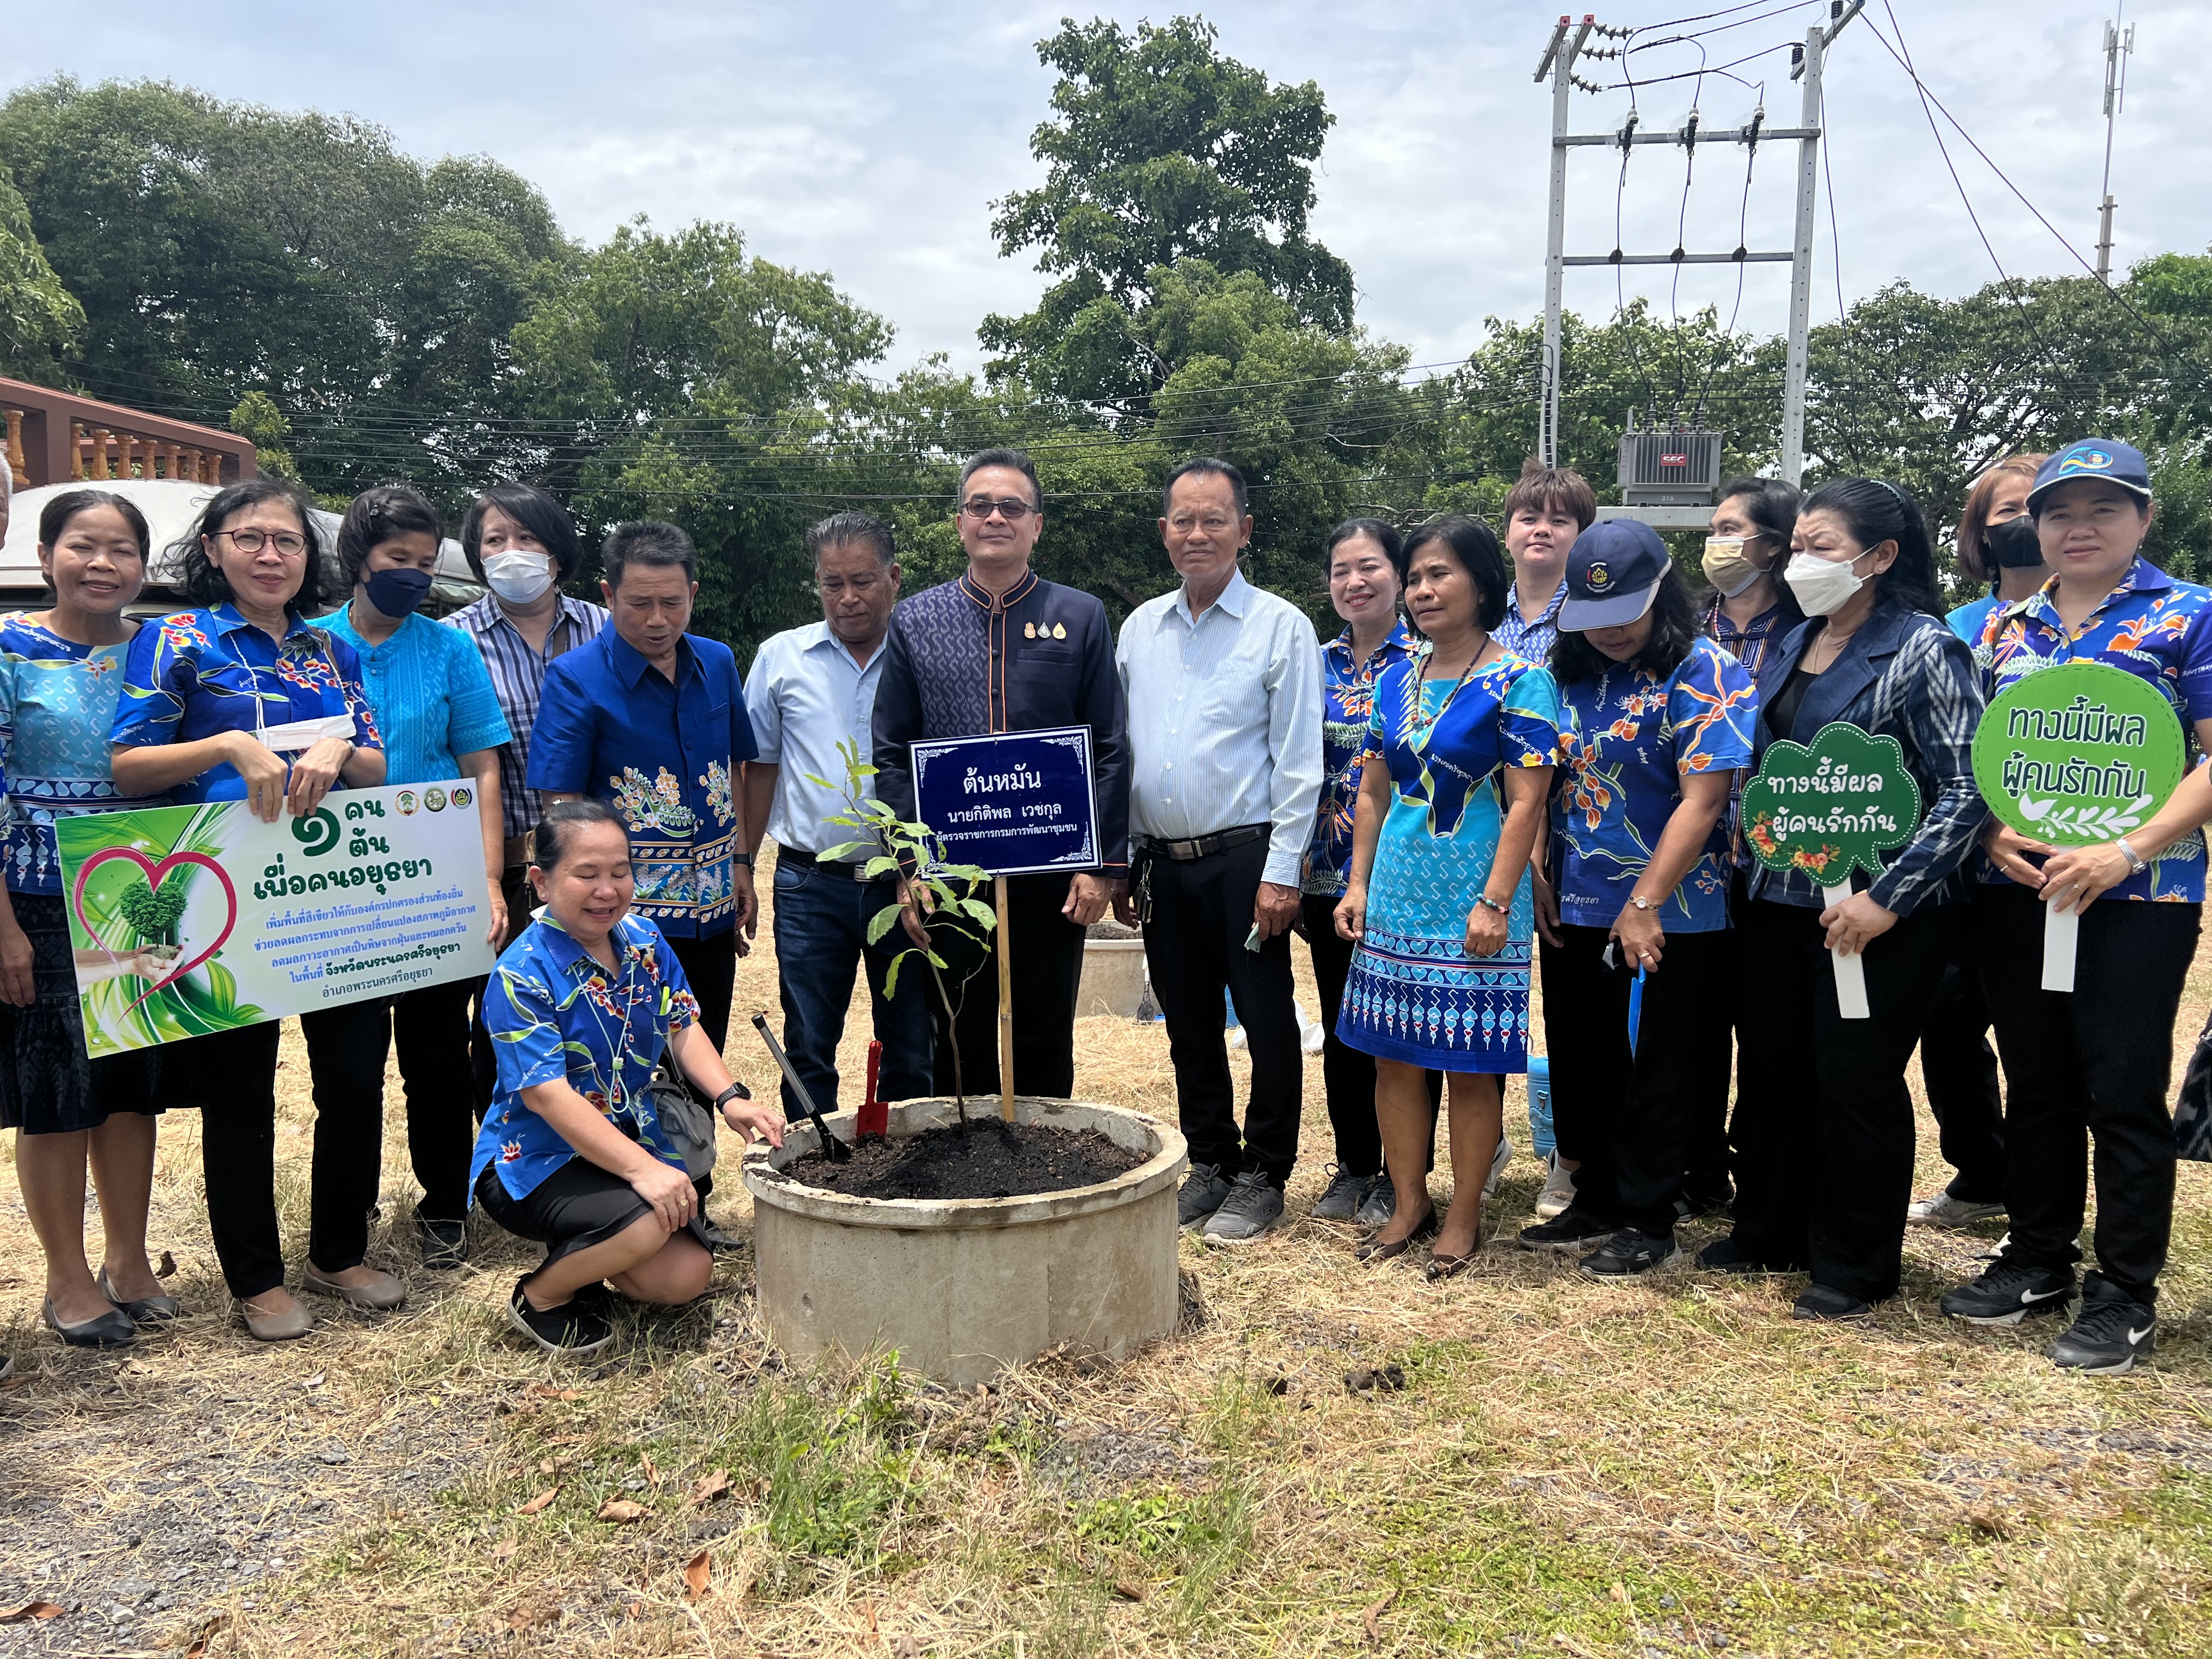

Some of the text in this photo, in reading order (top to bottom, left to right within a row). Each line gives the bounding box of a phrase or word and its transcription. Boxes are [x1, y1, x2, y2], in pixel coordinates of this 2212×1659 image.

[2008, 696, 2146, 746] ทางนี้มีผล
[963, 763, 1041, 794] ต้นหมัน
[1768, 756, 1883, 794] ทางนี้มีผล
[2002, 751, 2146, 798] ผู้คนรักกัน
[345, 800, 385, 820] คน
[947, 803, 1062, 823] นายกิติพล เวชกุล
[1773, 805, 1897, 842] ผู้คนรักกัน
[349, 827, 390, 857] ต้น
[253, 853, 432, 900] เพื่อคนอยุธยา
[266, 884, 463, 929] เพิ่มพื้นที่สีเขียวให้กับองค์กรปกครองส่วนท้องถิ่น
[254, 905, 476, 951] ช่วยลดผลกระทบจากการเปลี่ยนแปลงสภาพภูมิอากาศ
[272, 922, 467, 967] ลดมลภาวะอากาศเป็นพิษจากฝุ่นและหมอกควัน
[289, 943, 461, 983] ในพื้นที่ จังหวัดพระนครศรีอยุธยา
[322, 967, 433, 998] อำเภอพระนครศรีอยุธยา
